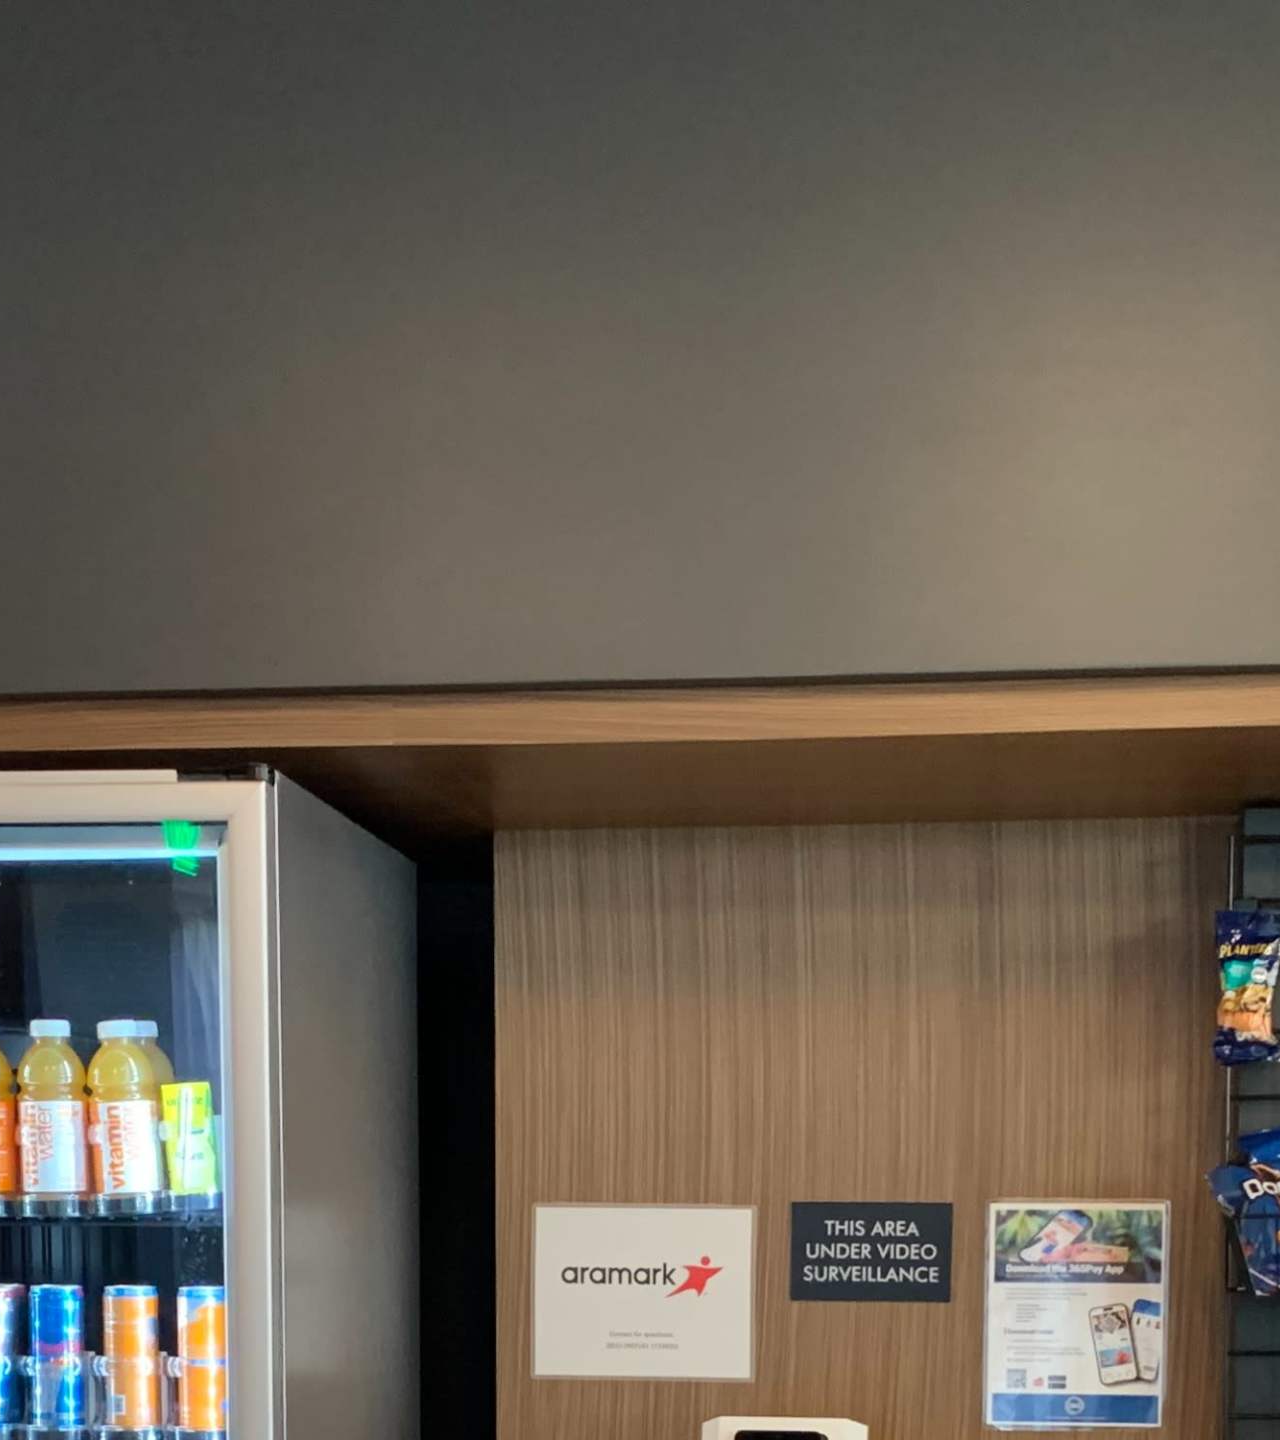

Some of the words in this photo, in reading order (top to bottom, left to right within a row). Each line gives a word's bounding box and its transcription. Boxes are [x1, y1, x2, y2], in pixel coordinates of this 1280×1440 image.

[107, 1104, 126, 1190] vitamin
[824, 1220, 866, 1237] THIS
[870, 1220, 920, 1237] AREA
[805, 1242, 872, 1261] UNDER
[877, 1243, 938, 1261] VIDEO
[561, 1262, 676, 1286] aramark
[802, 1265, 940, 1284] SURVEILLANCE
[1104, 1264, 1125, 1275] App
